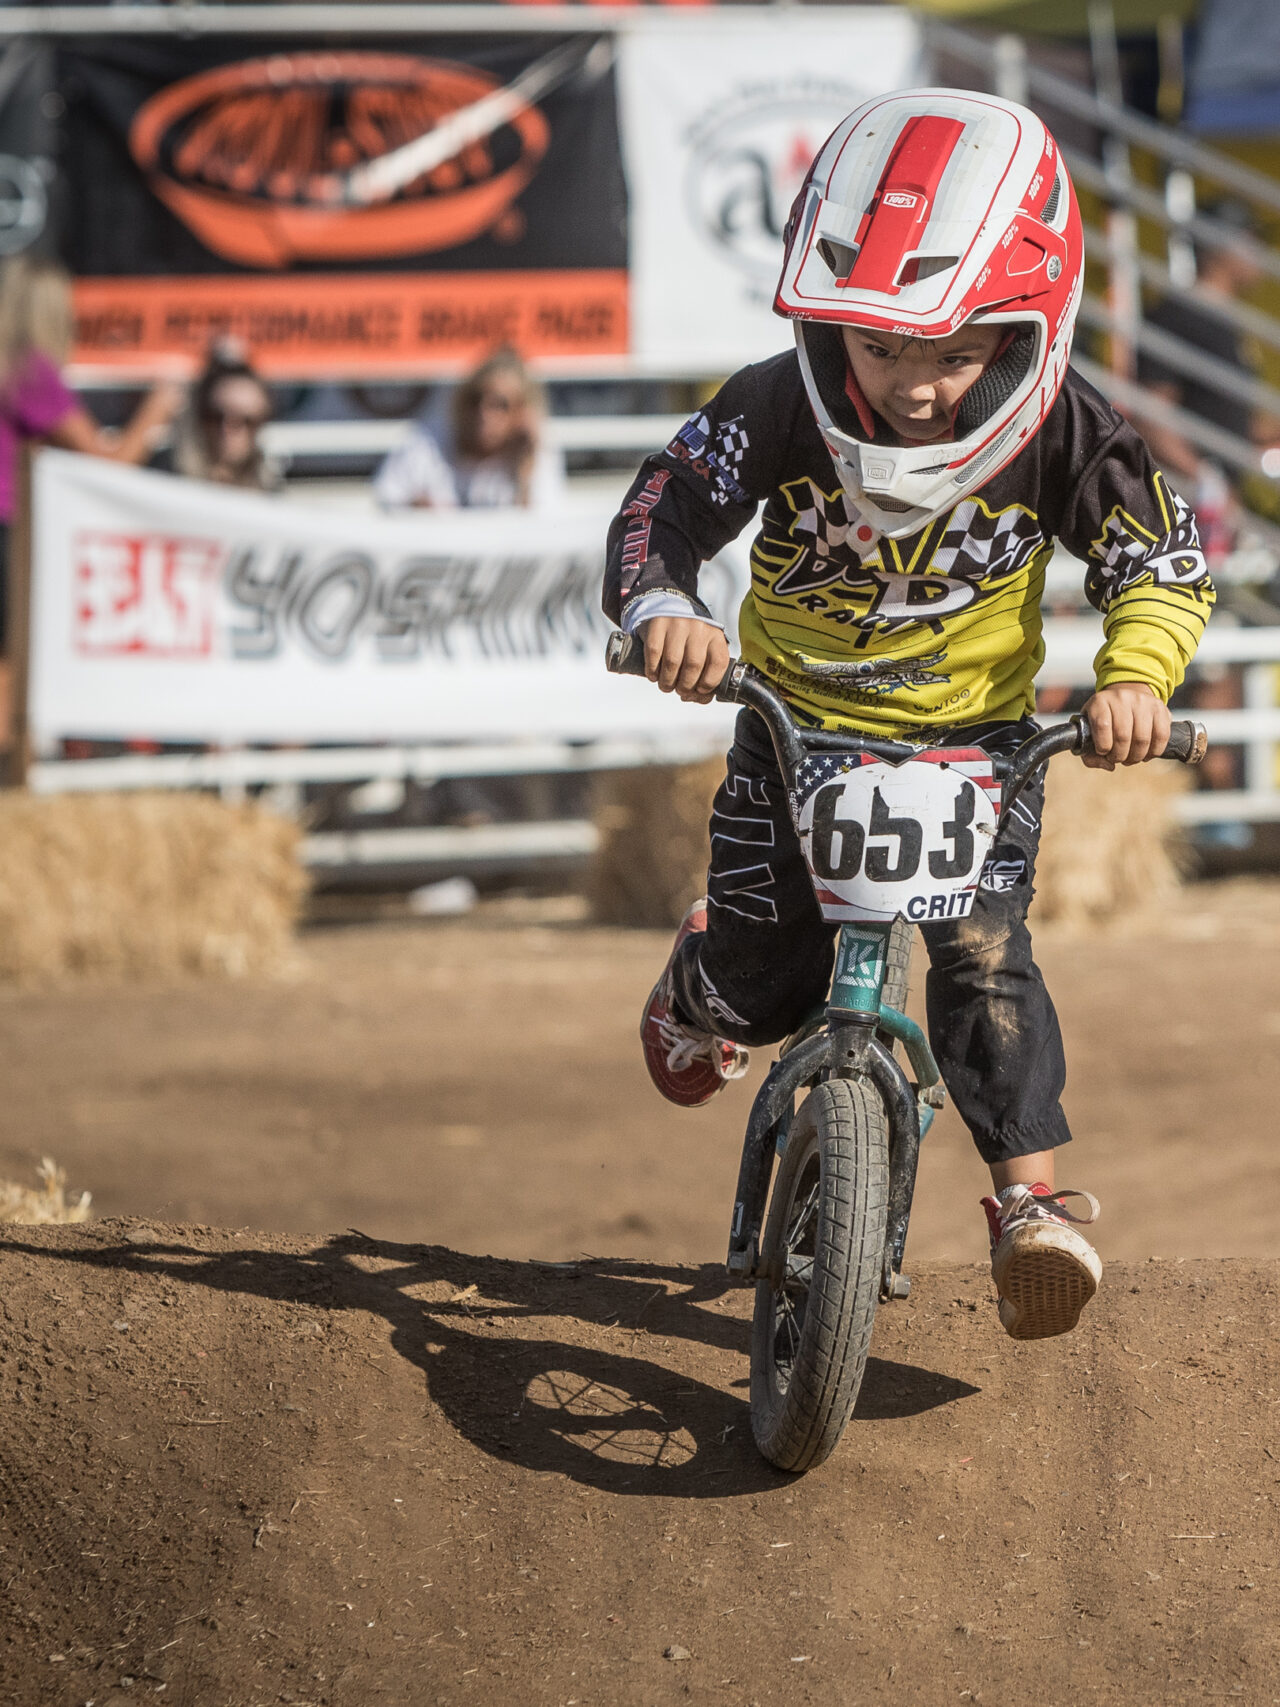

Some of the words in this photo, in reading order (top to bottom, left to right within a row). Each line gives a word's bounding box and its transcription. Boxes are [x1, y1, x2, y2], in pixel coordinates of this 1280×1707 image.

[887, 194, 912, 206] 100%
[1001, 222, 1019, 249] 100%
[975, 264, 992, 292] 100%
[949, 304, 967, 329] 100%
[891, 324, 924, 337] 100%
[811, 780, 976, 883] 653
[906, 891, 973, 920] CRIT
